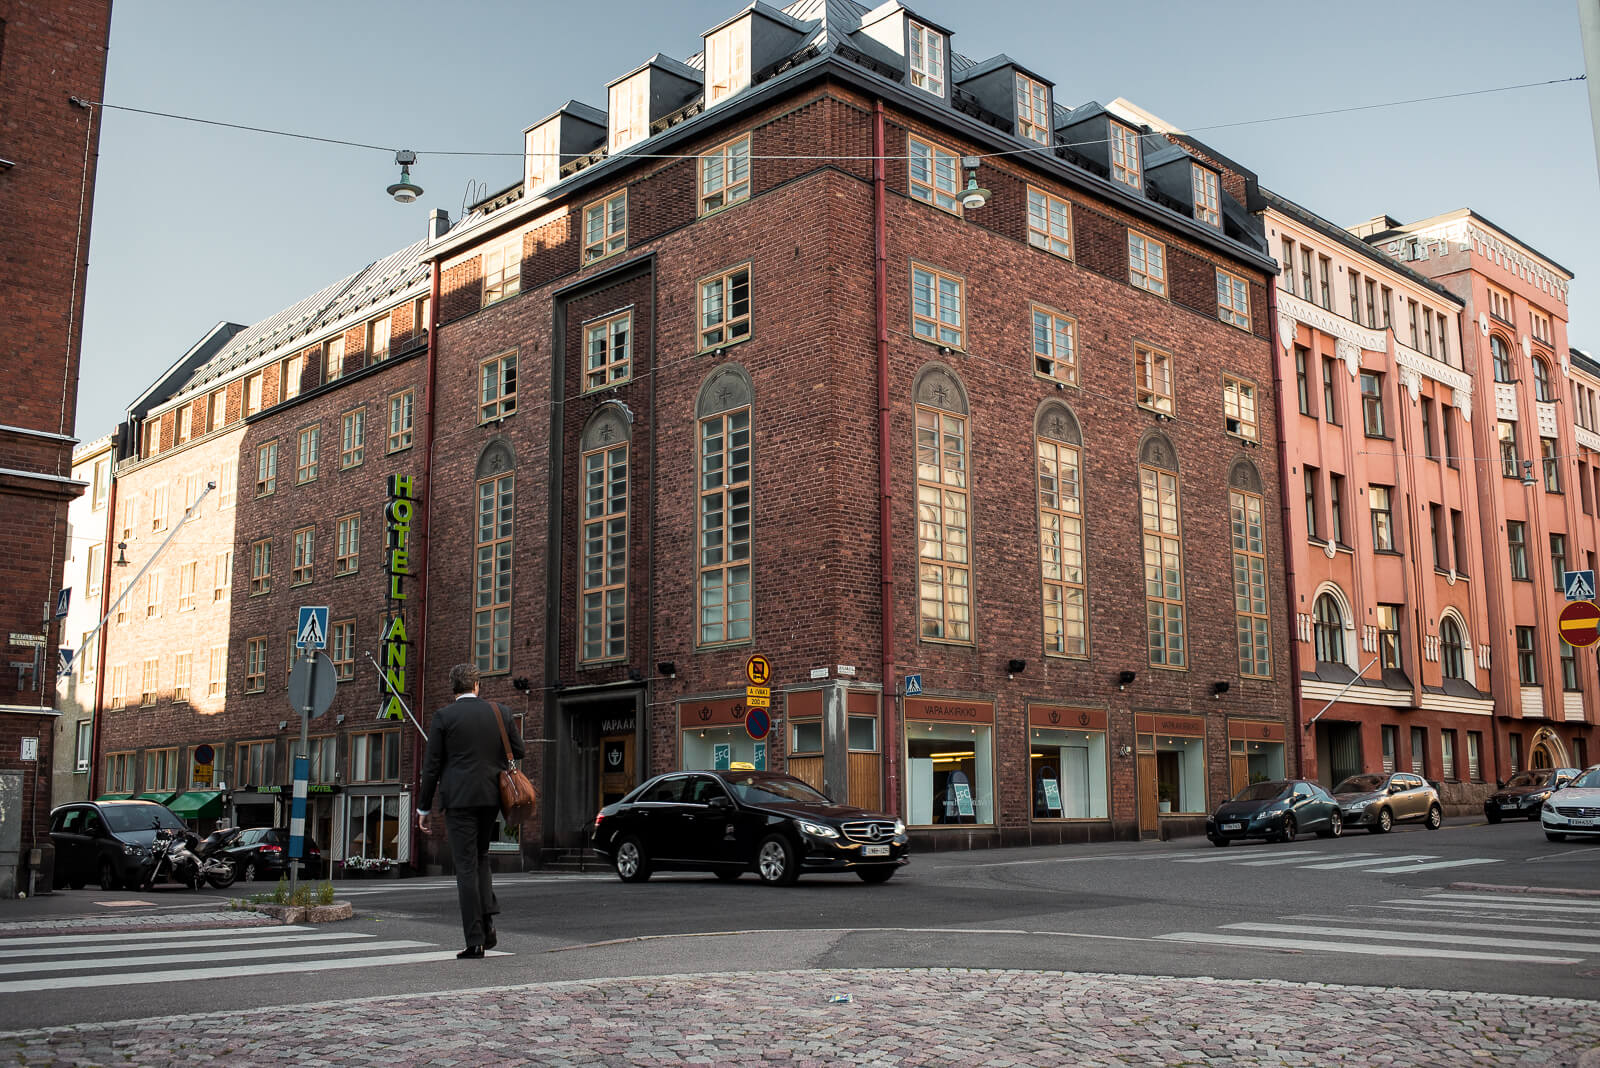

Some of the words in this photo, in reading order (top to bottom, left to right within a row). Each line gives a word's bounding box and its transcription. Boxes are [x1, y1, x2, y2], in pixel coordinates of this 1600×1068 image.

[391, 473, 413, 600] HOTEL
[386, 616, 407, 720] ANNA
[307, 784, 333, 793] HOTEL
